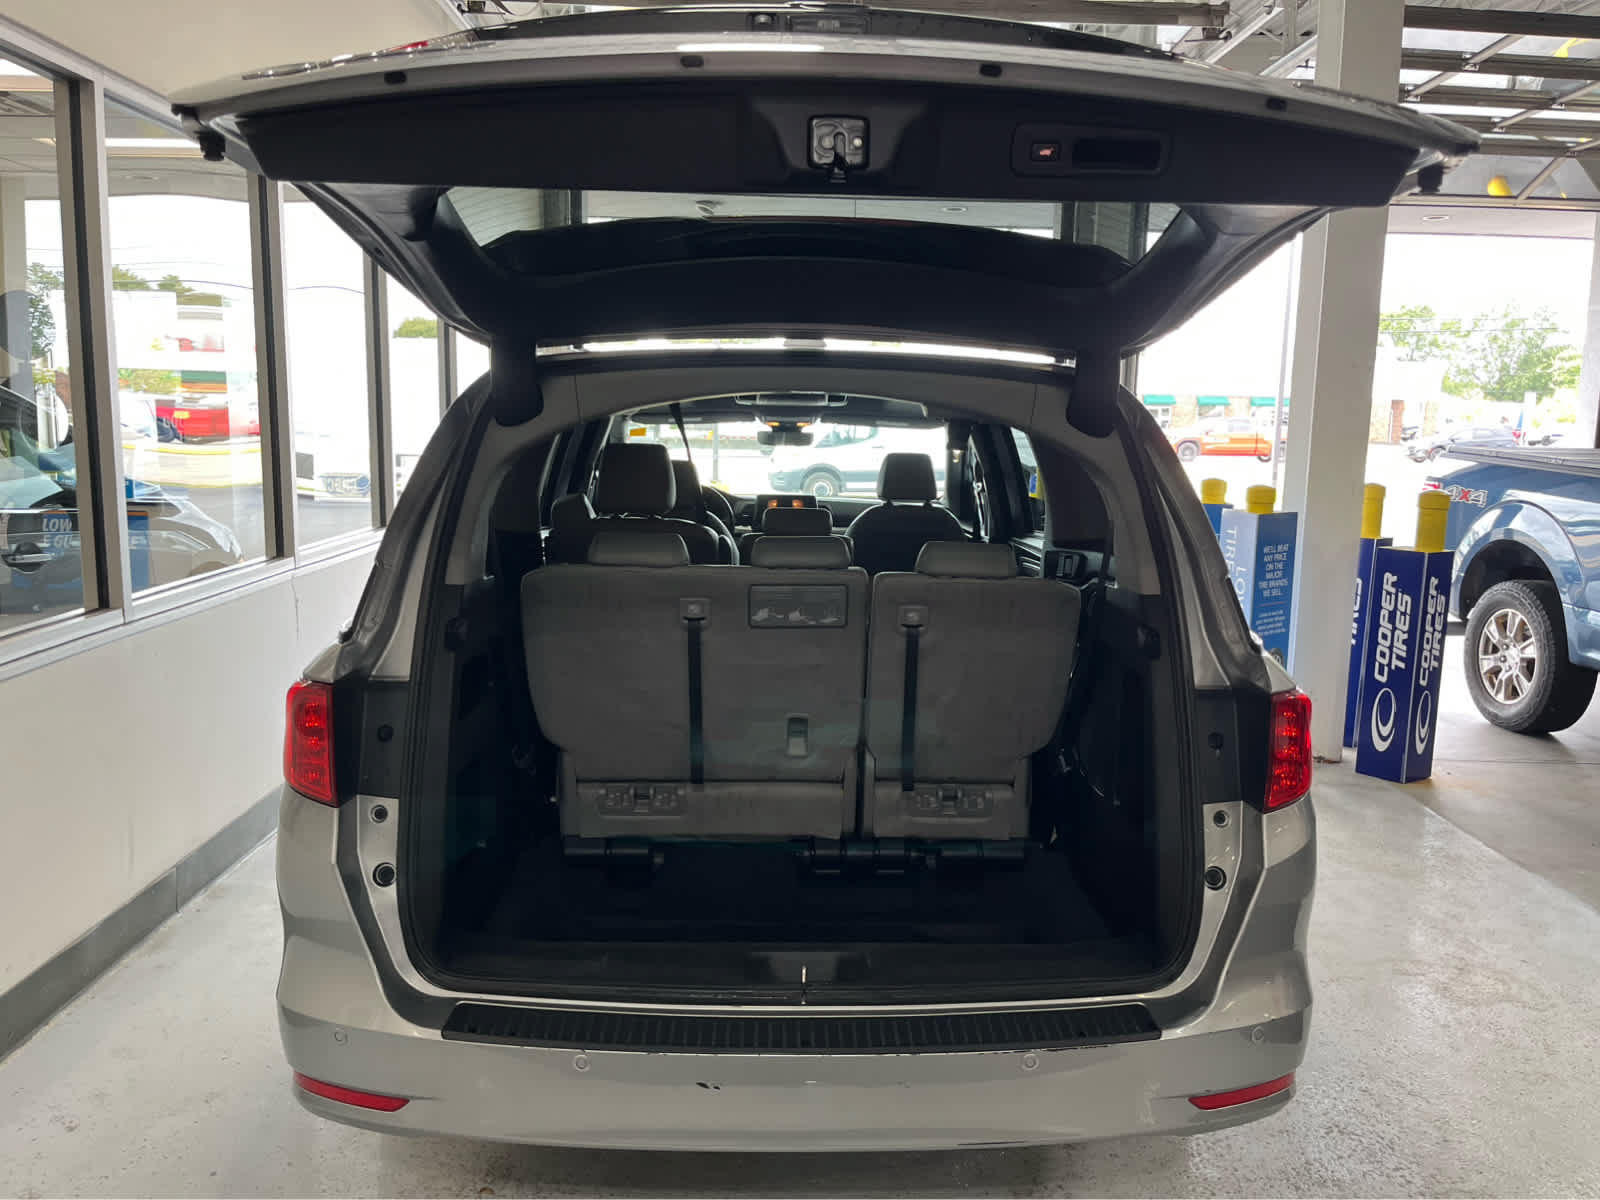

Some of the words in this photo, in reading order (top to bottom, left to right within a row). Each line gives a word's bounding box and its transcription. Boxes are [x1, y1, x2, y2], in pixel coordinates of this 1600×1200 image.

[42, 518, 72, 532] LOW
[1225, 527, 1237, 573] TIRE
[1264, 554, 1273, 562] ANY
[1273, 552, 1287, 561] PRICE
[1265, 562, 1274, 571] ON
[1274, 561, 1284, 570] THE
[1263, 588, 1271, 597] WE
[1374, 572, 1397, 683] COOPER
[1391, 592, 1412, 670] TIRES
[1420, 577, 1439, 687] COOPER
[1430, 594, 1446, 671] TIRES
